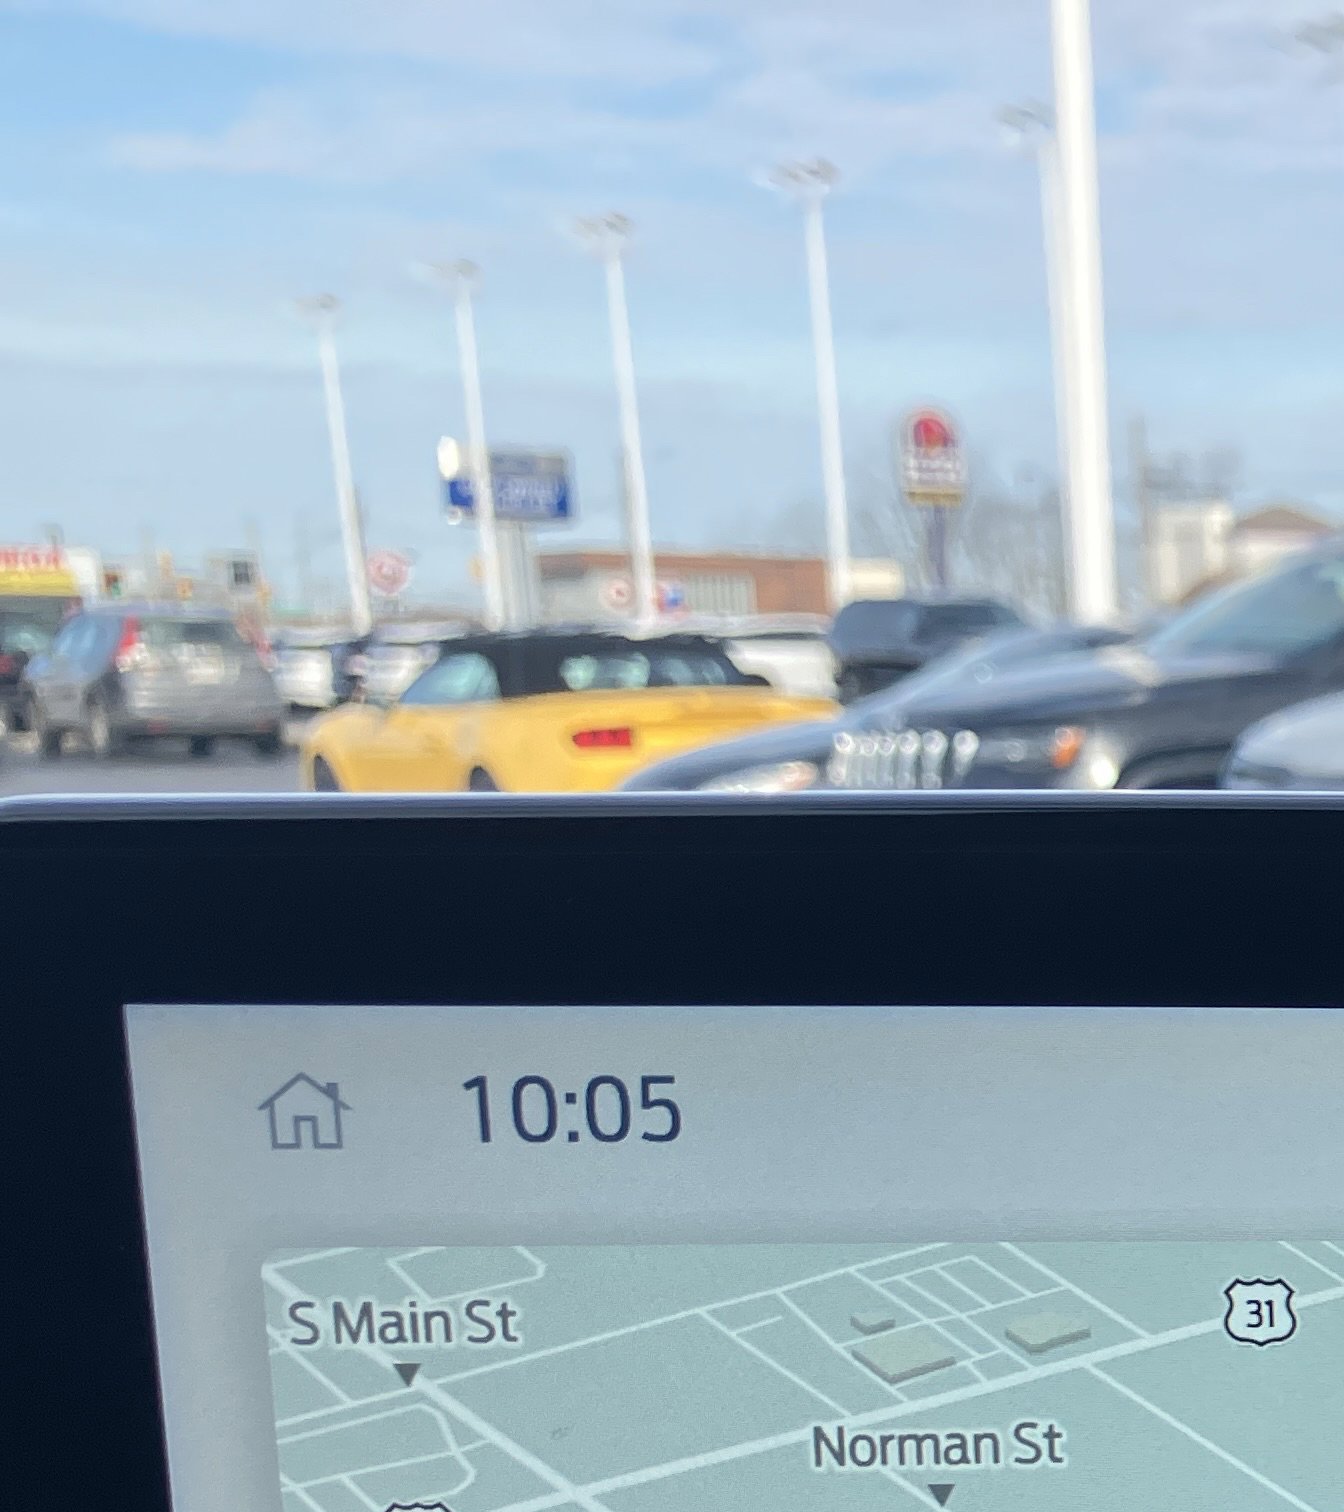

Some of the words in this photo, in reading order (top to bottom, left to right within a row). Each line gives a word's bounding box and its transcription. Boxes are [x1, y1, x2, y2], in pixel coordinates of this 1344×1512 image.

[463, 1074, 682, 1144] 10:05
[288, 1301, 320, 1345] S
[333, 1301, 452, 1344] Main
[465, 1299, 519, 1343] St
[1245, 1299, 1276, 1329] 31
[812, 1425, 1000, 1468] Norman
[1013, 1421, 1064, 1465] St
